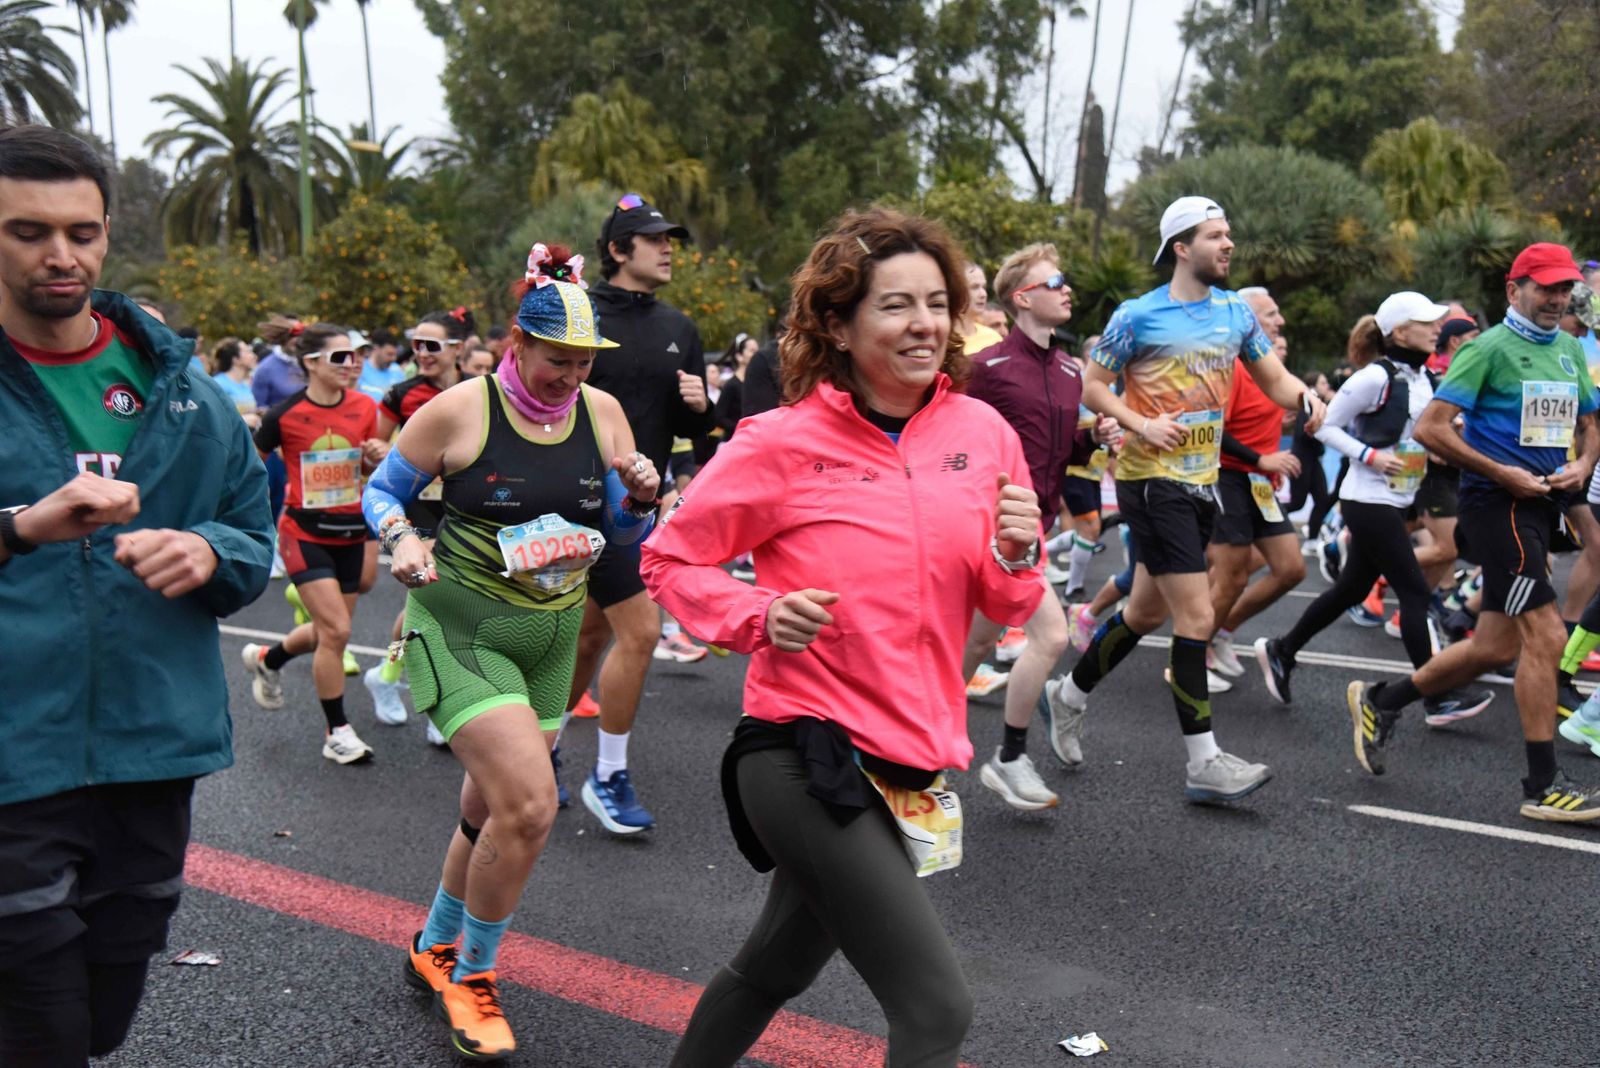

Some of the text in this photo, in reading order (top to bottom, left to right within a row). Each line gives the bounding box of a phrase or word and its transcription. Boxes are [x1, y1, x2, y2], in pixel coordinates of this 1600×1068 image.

[168, 399, 199, 414] FILA
[1530, 398, 1574, 419] 19741
[312, 463, 351, 482] 6980
[514, 533, 593, 570] 19263
